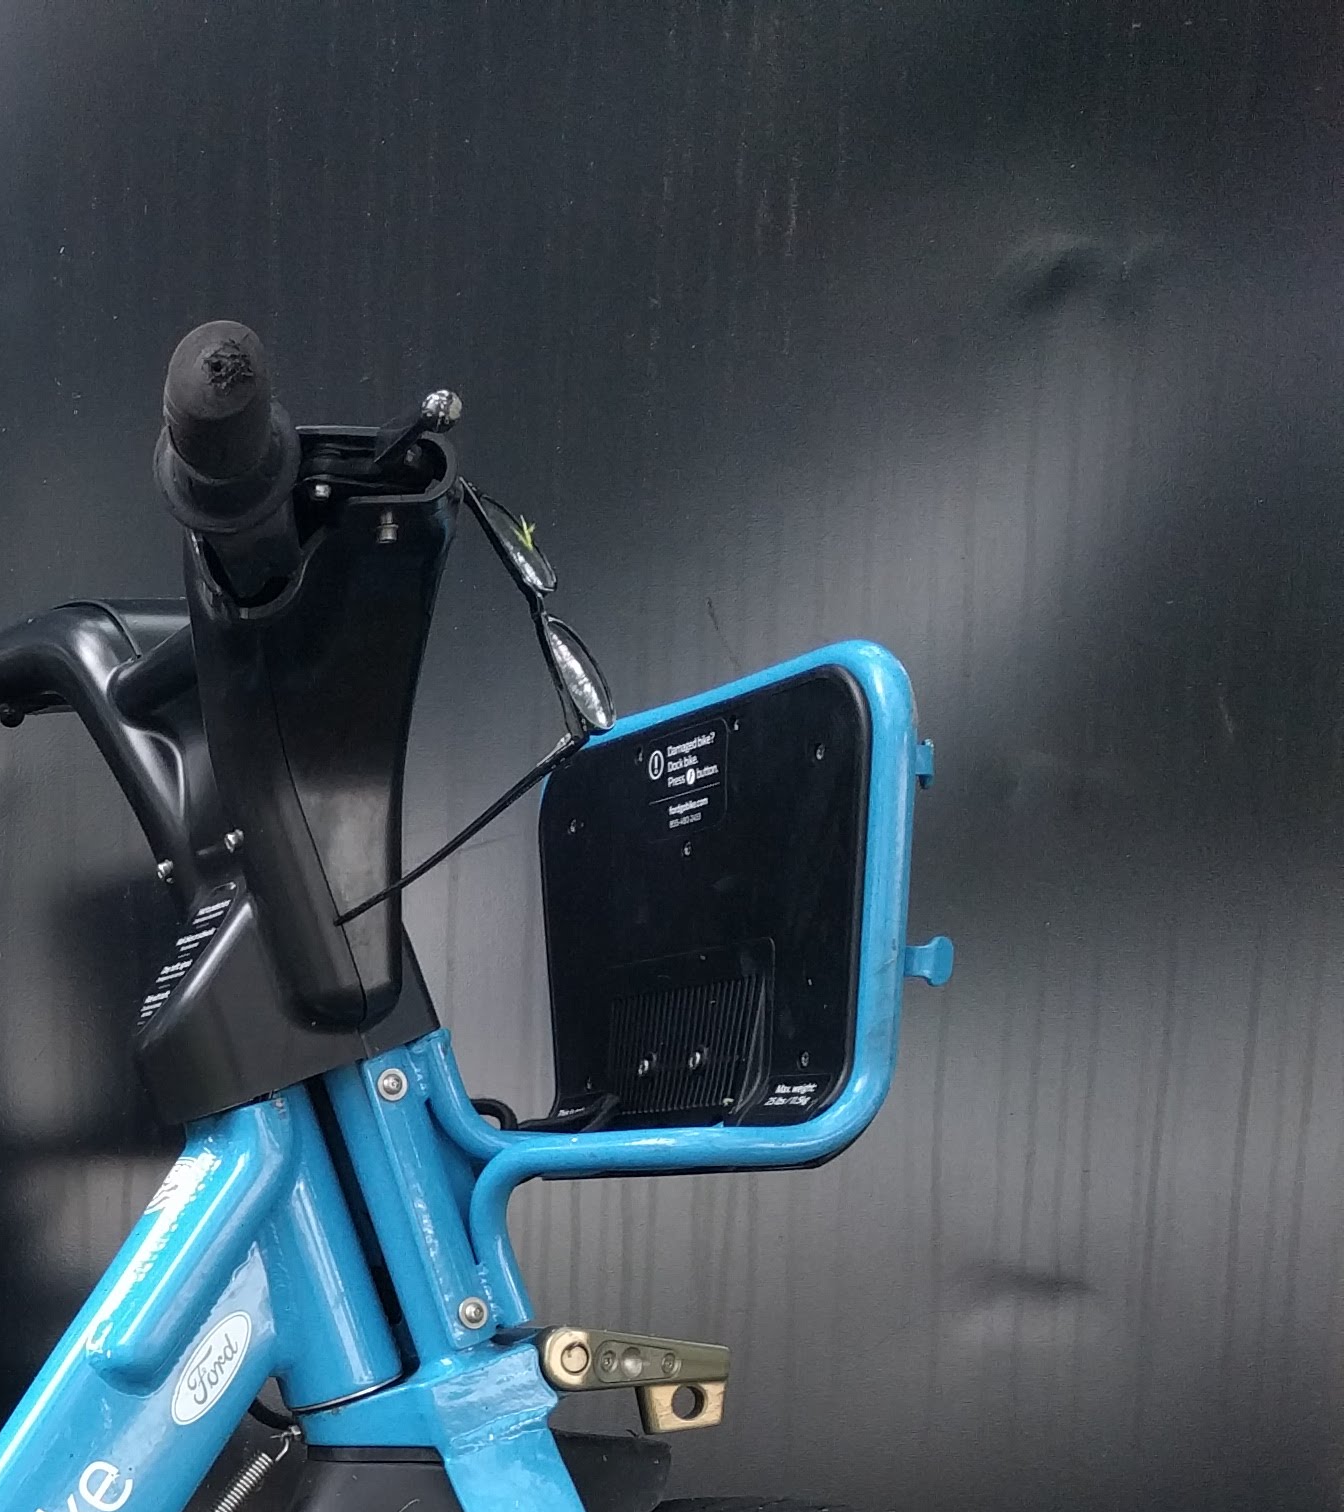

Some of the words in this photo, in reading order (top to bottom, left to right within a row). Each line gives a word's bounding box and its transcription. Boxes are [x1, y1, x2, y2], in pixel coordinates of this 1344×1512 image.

[666, 736, 698, 758] Damaged
[697, 731, 717, 748] bike?
[667, 758, 684, 773] Dock
[667, 774, 686, 788] Press
[186, 1333, 239, 1406] Ford
